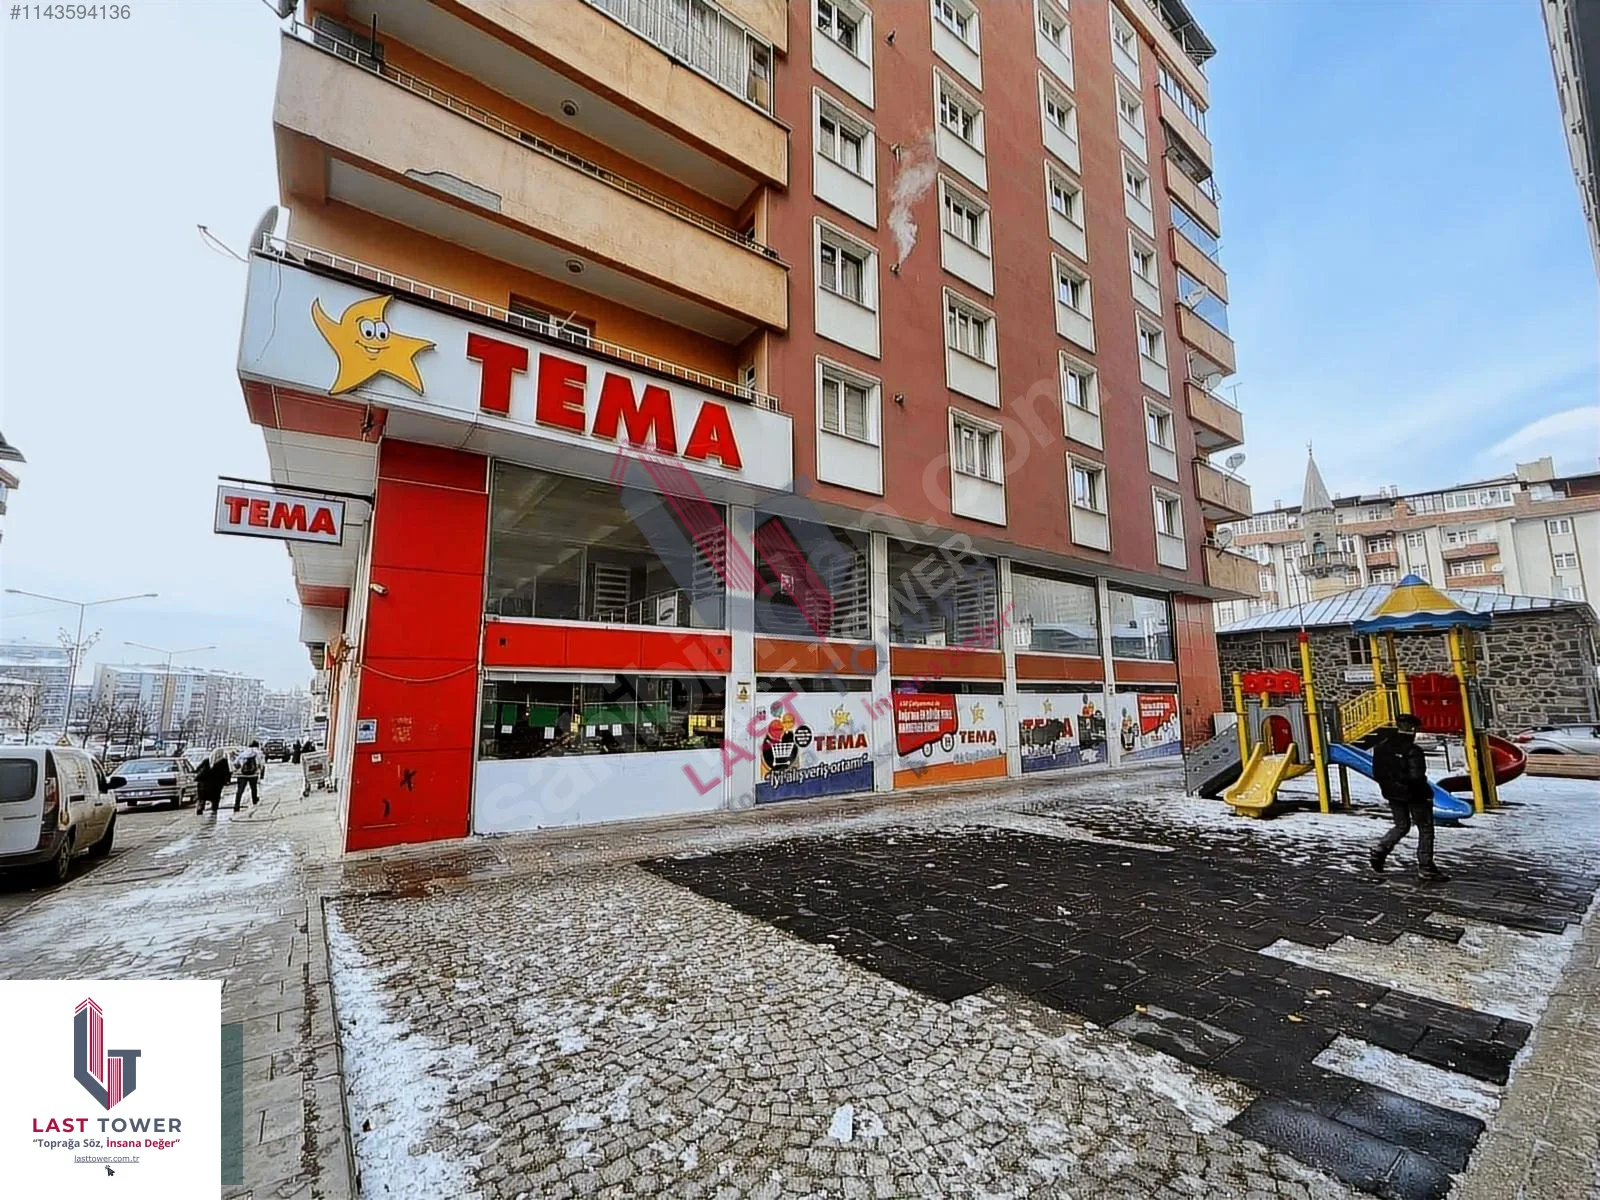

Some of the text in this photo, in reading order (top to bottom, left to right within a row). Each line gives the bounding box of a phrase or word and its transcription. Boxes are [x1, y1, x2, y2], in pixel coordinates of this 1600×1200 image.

[466, 332, 743, 470] TEMA
[224, 496, 336, 535] TEMA
[814, 734, 868, 752] TEMA
[959, 730, 997, 744] TEMA
